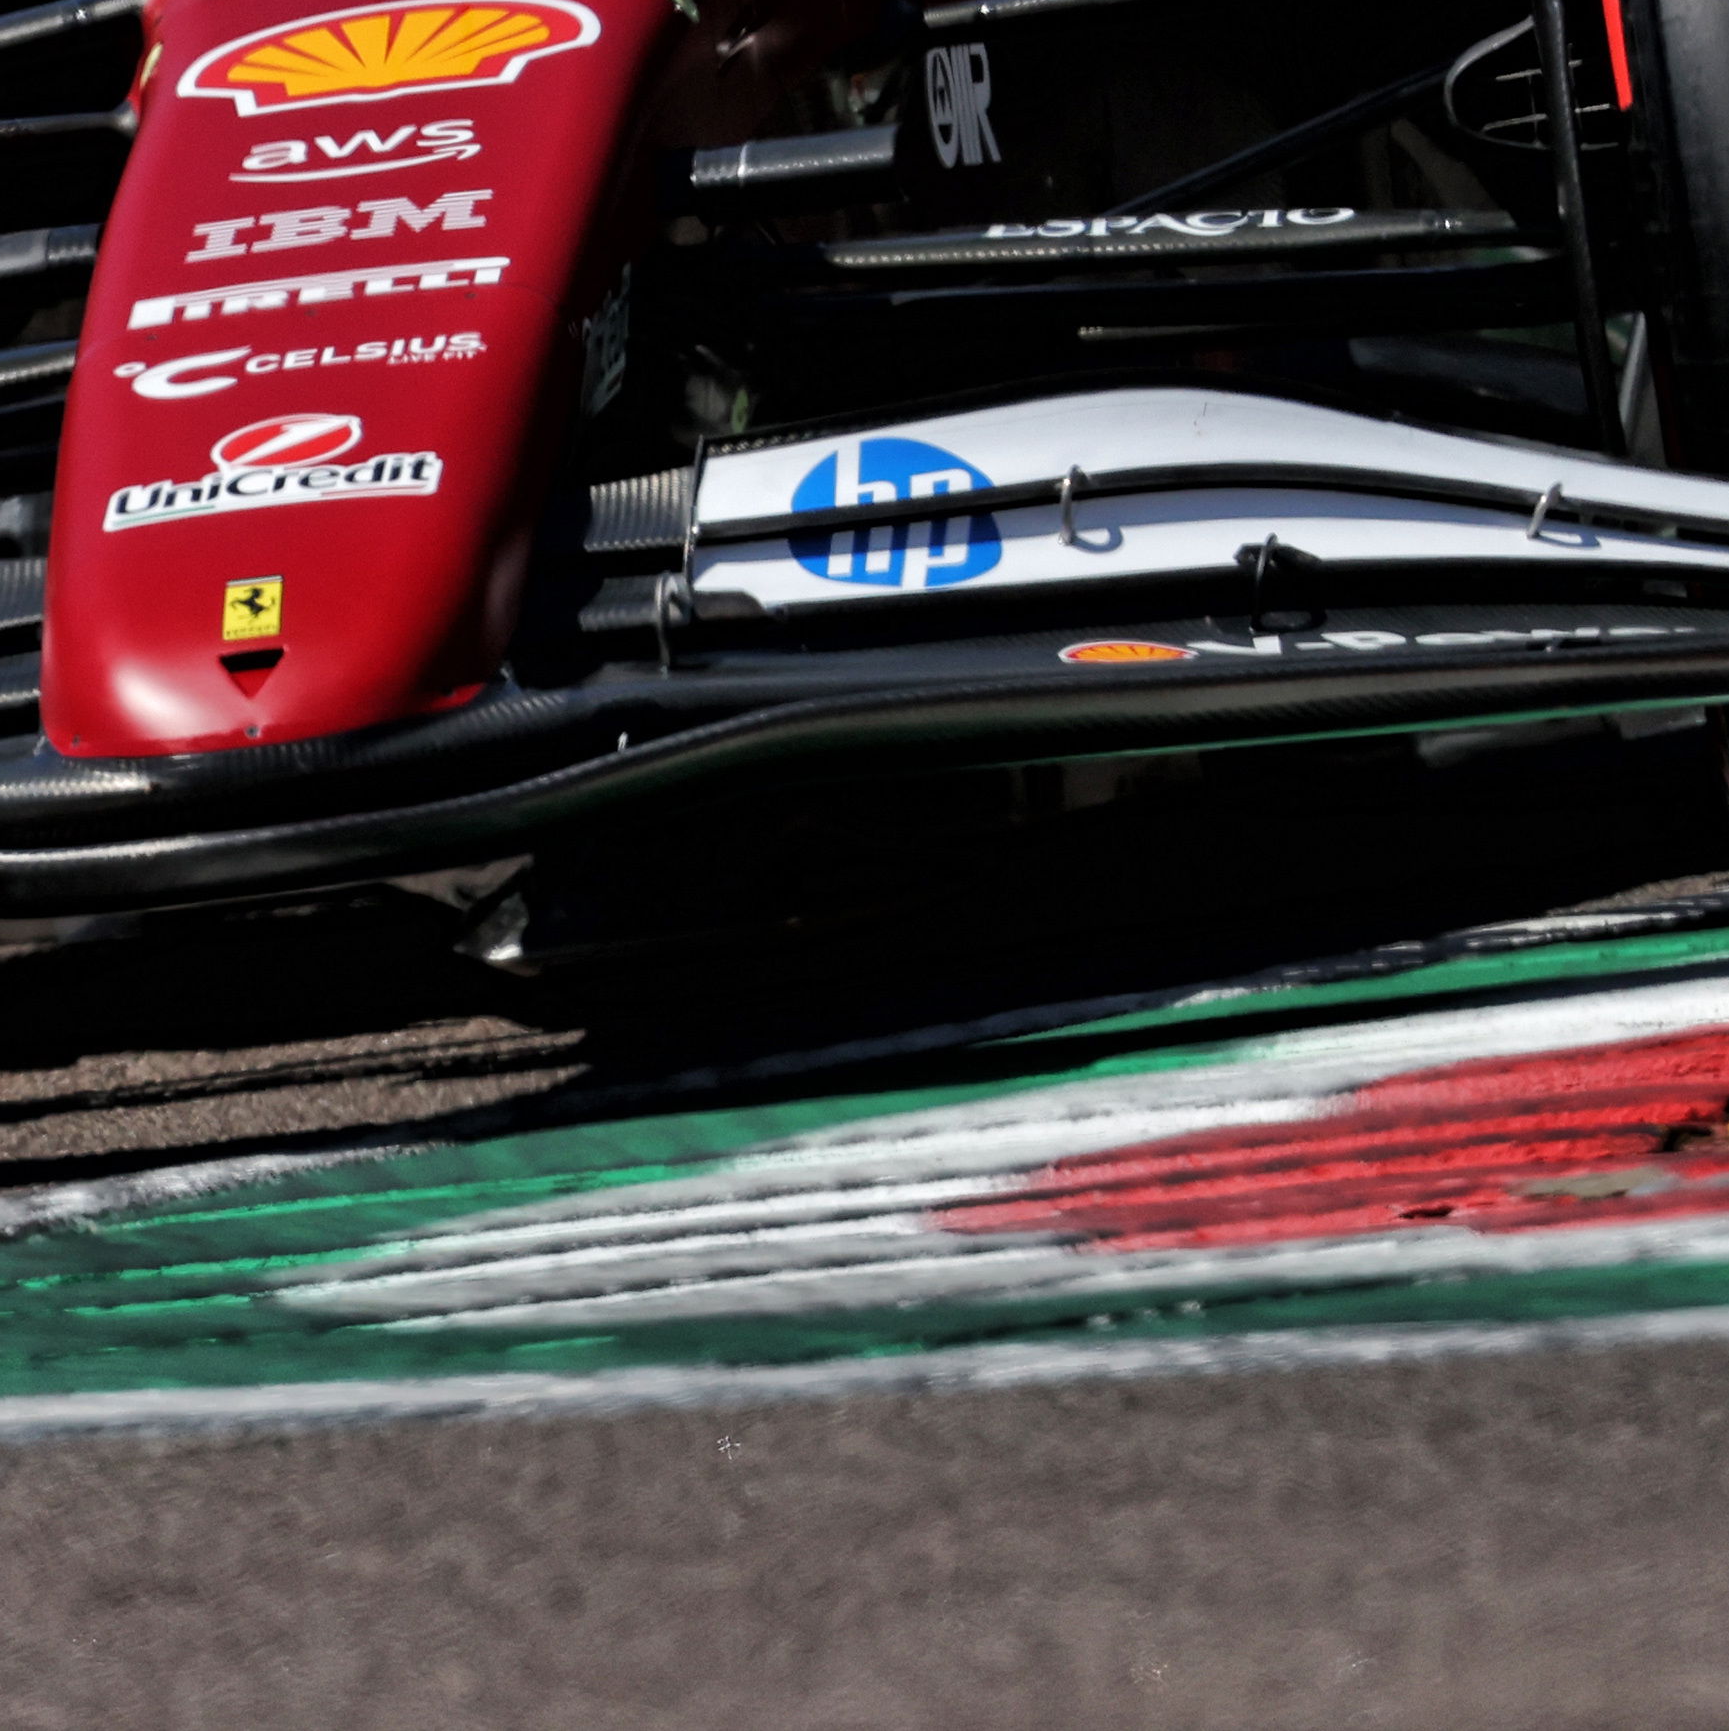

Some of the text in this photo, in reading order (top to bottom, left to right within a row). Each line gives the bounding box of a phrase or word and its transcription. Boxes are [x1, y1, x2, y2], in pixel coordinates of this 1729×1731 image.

[242, 119, 476, 171] aws
[184, 189, 494, 263] IBM
[127, 256, 512, 330] PIRELLI
[244, 332, 482, 374] CELSIUS
[115, 454, 432, 515] UniCredit
[822, 438, 974, 589] hp
